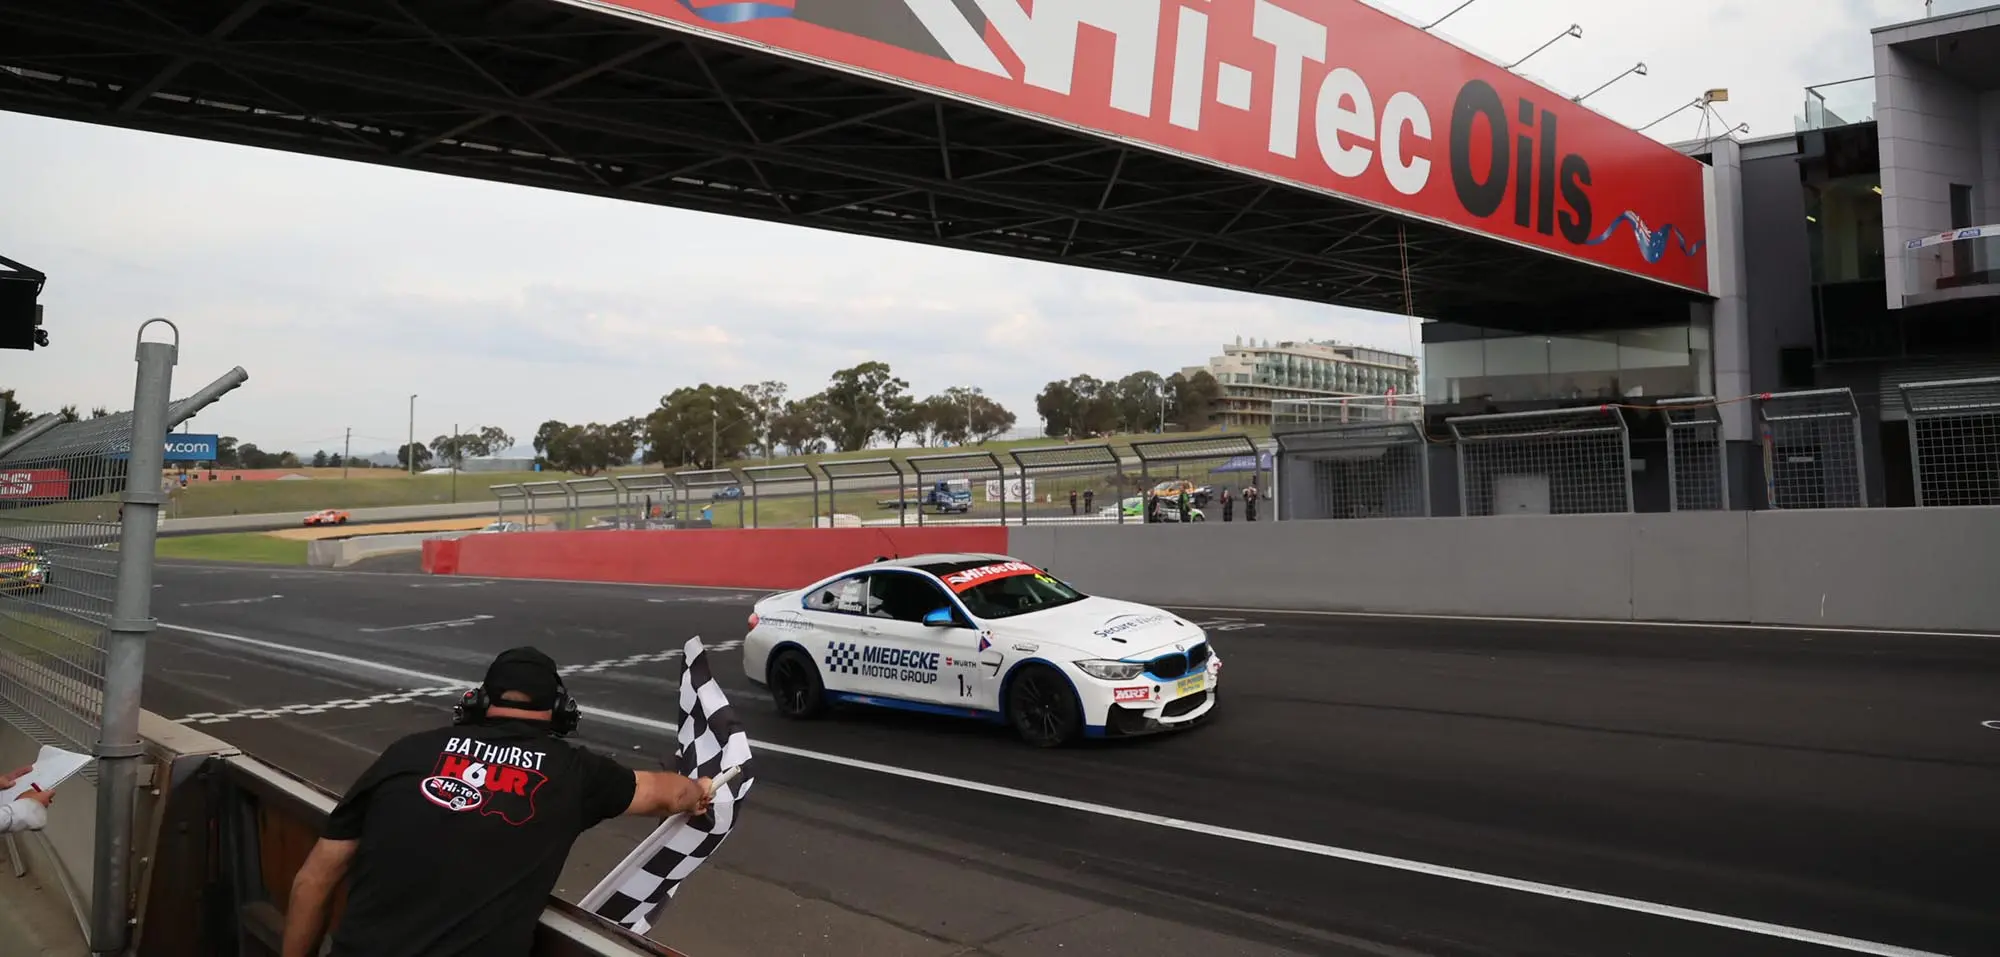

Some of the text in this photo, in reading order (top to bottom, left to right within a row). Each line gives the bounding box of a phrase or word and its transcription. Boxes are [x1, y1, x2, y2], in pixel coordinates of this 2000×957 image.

[1018, 0, 1594, 246] Hi-Tec Oils
[1093, 621, 1137, 638] Secure
[863, 645, 941, 670] MIEDECKE
[861, 664, 938, 685] MOTOR GROUP
[444, 737, 547, 771] BATHURST
[442, 780, 480, 800] Hi-Tec
